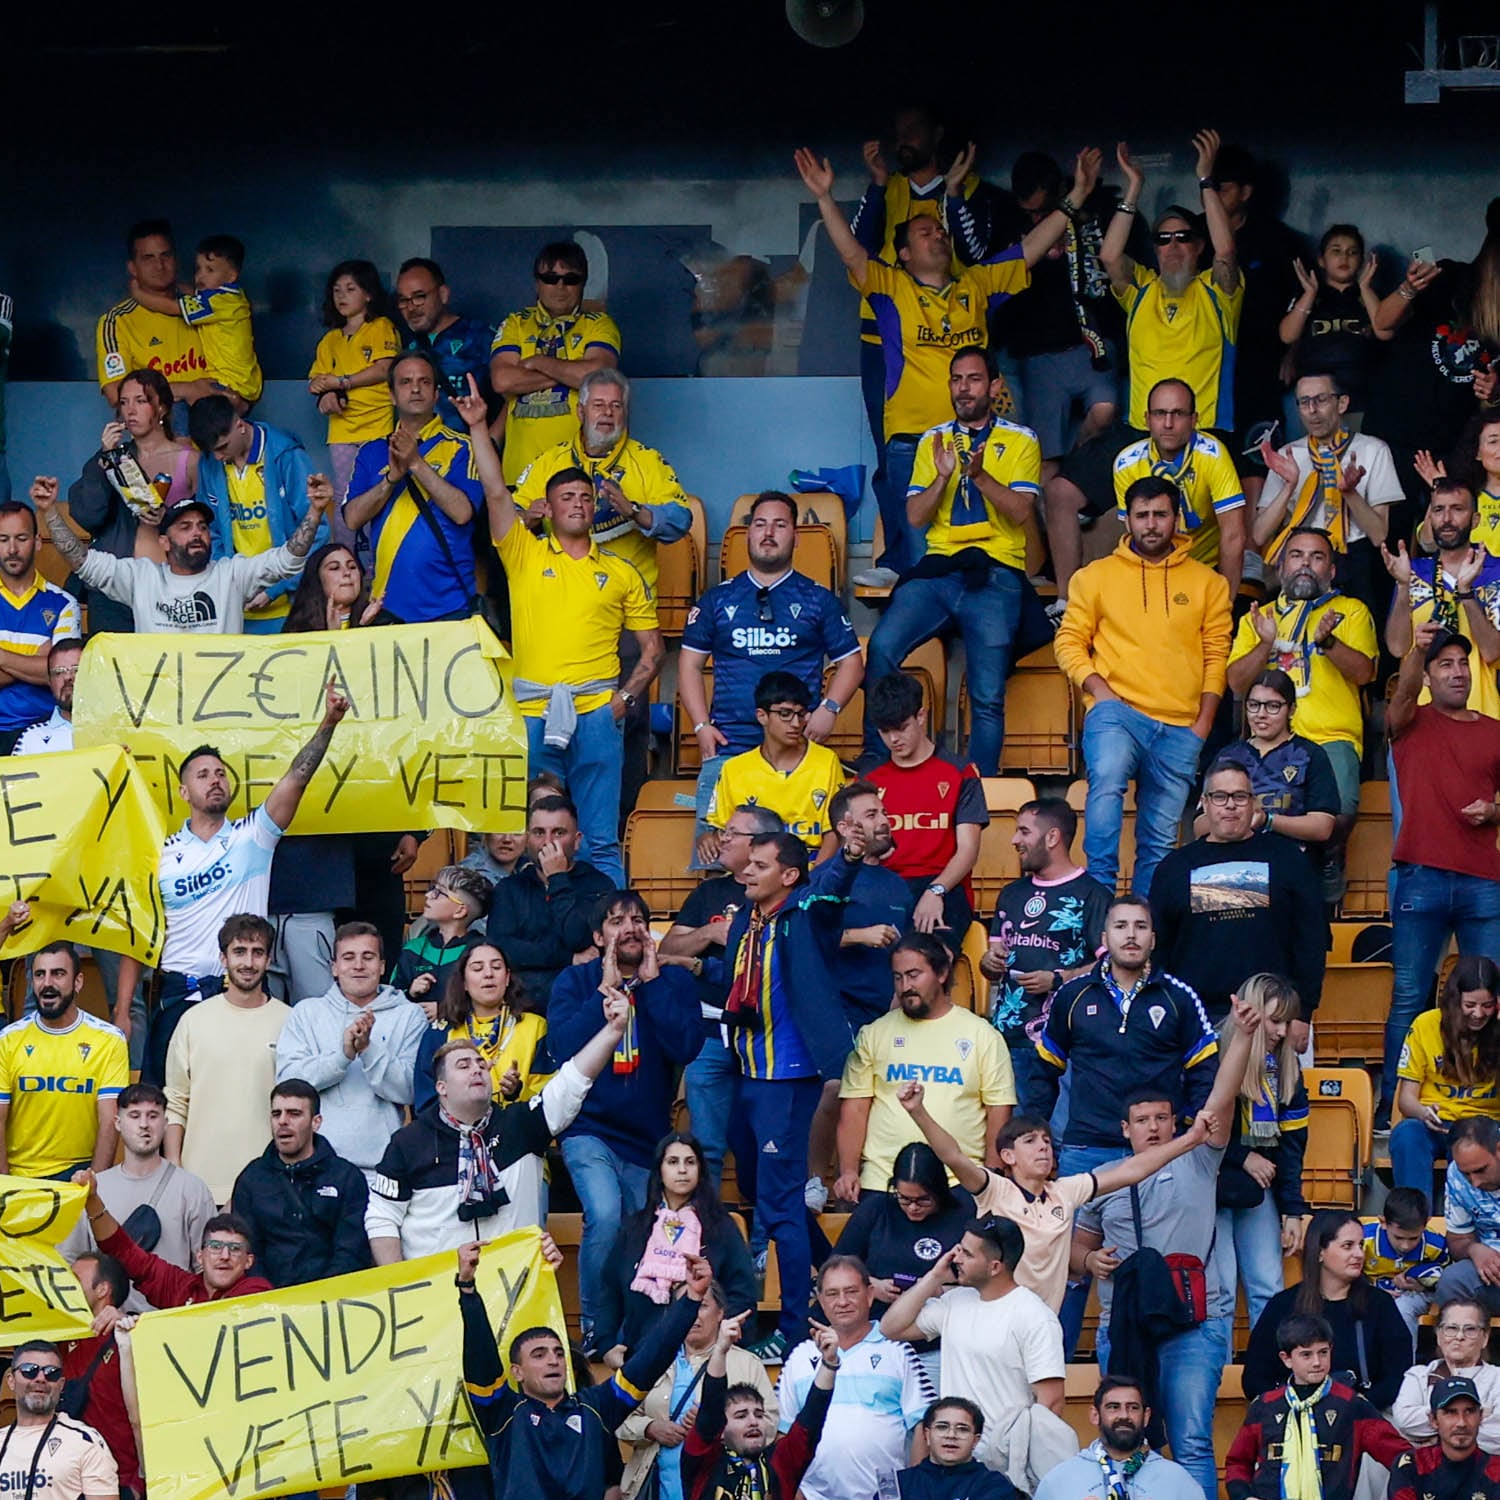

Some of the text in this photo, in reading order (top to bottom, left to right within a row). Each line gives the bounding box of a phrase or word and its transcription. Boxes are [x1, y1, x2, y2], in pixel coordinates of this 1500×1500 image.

[156, 600, 195, 615] NORTH
[176, 611, 196, 624] FACE
[747, 648, 781, 656] Telecom
[317, 752, 358, 814] Y
[398, 750, 529, 814] VETE
[93, 764, 135, 845] Y
[18, 1075, 95, 1094] DIGI
[886, 1062, 965, 1086] MEYBA
[162, 1265, 531, 1409] VENDE Y
[202, 1394, 374, 1498] VETE
